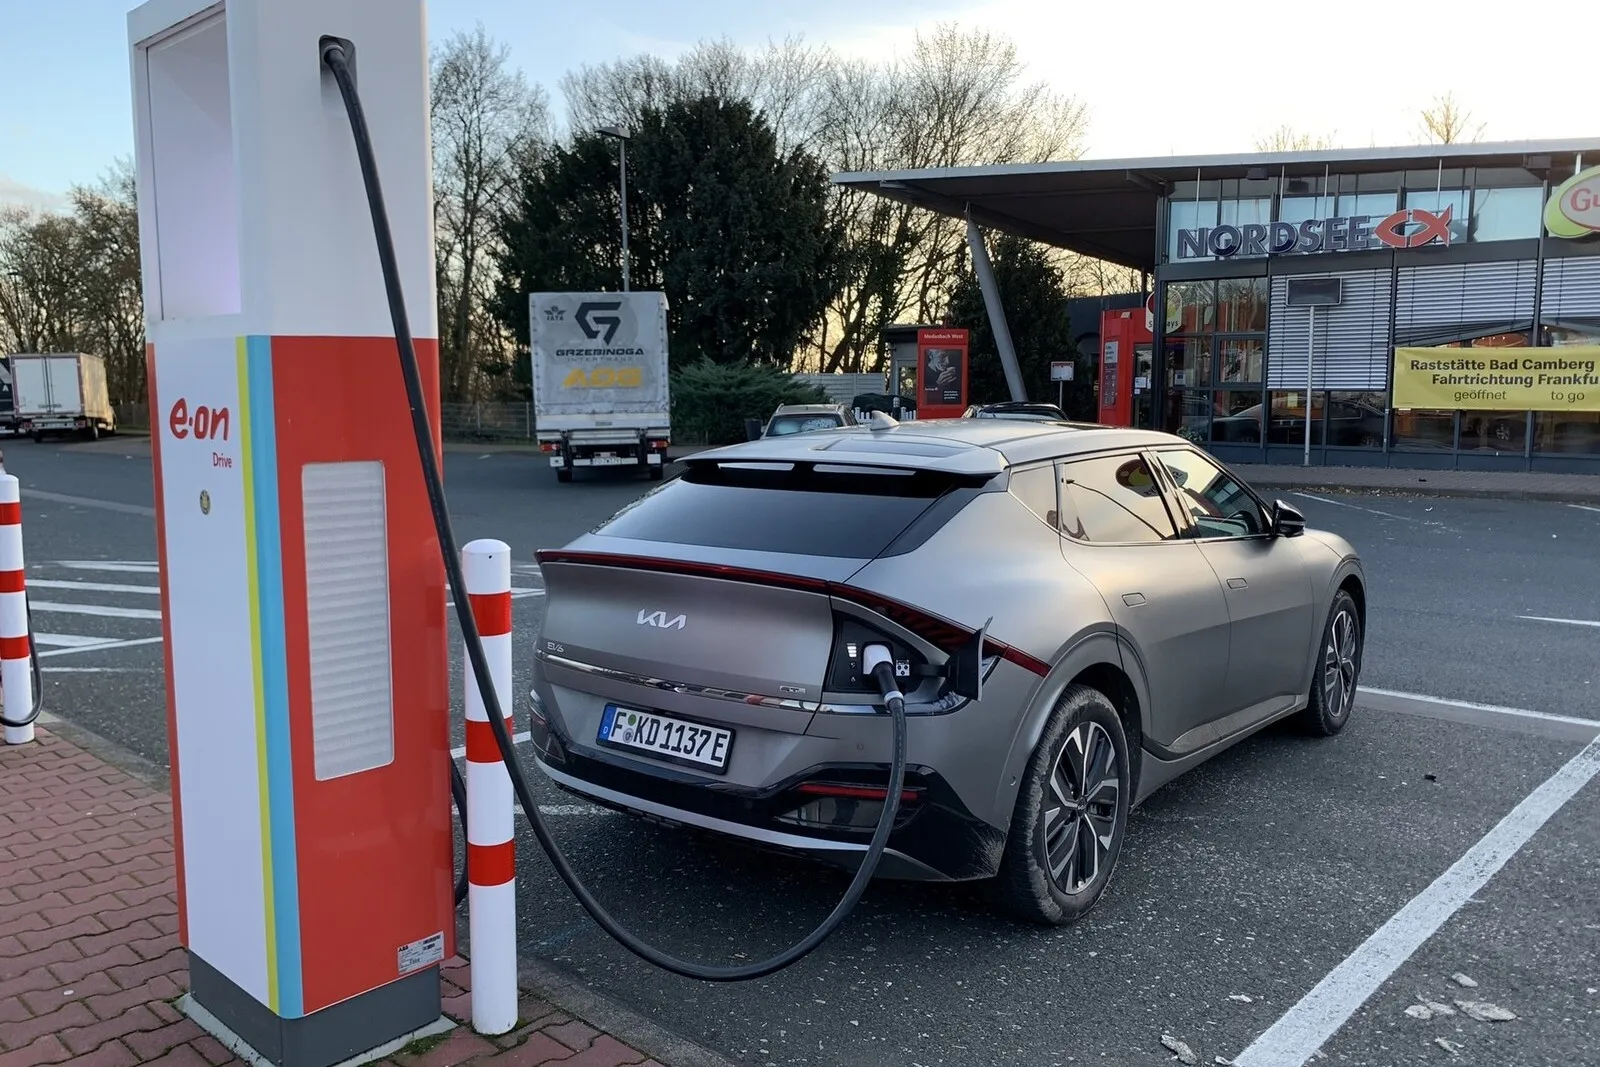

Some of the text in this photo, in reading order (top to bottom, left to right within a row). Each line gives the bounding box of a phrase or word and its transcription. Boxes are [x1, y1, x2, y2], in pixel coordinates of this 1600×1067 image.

[1177, 215, 1370, 258] NORDSEE
[1148, 320, 1179, 328] Says
[555, 348, 644, 357] GRZEBINOGA
[1410, 358, 1595, 373] Raststätte Bad Camberg
[1432, 373, 1533, 387] Fahrtrichtung
[1454, 389, 1585, 403] geöffnet to go
[212, 452, 233, 468] Drive
[547, 641, 564, 653] EV6
